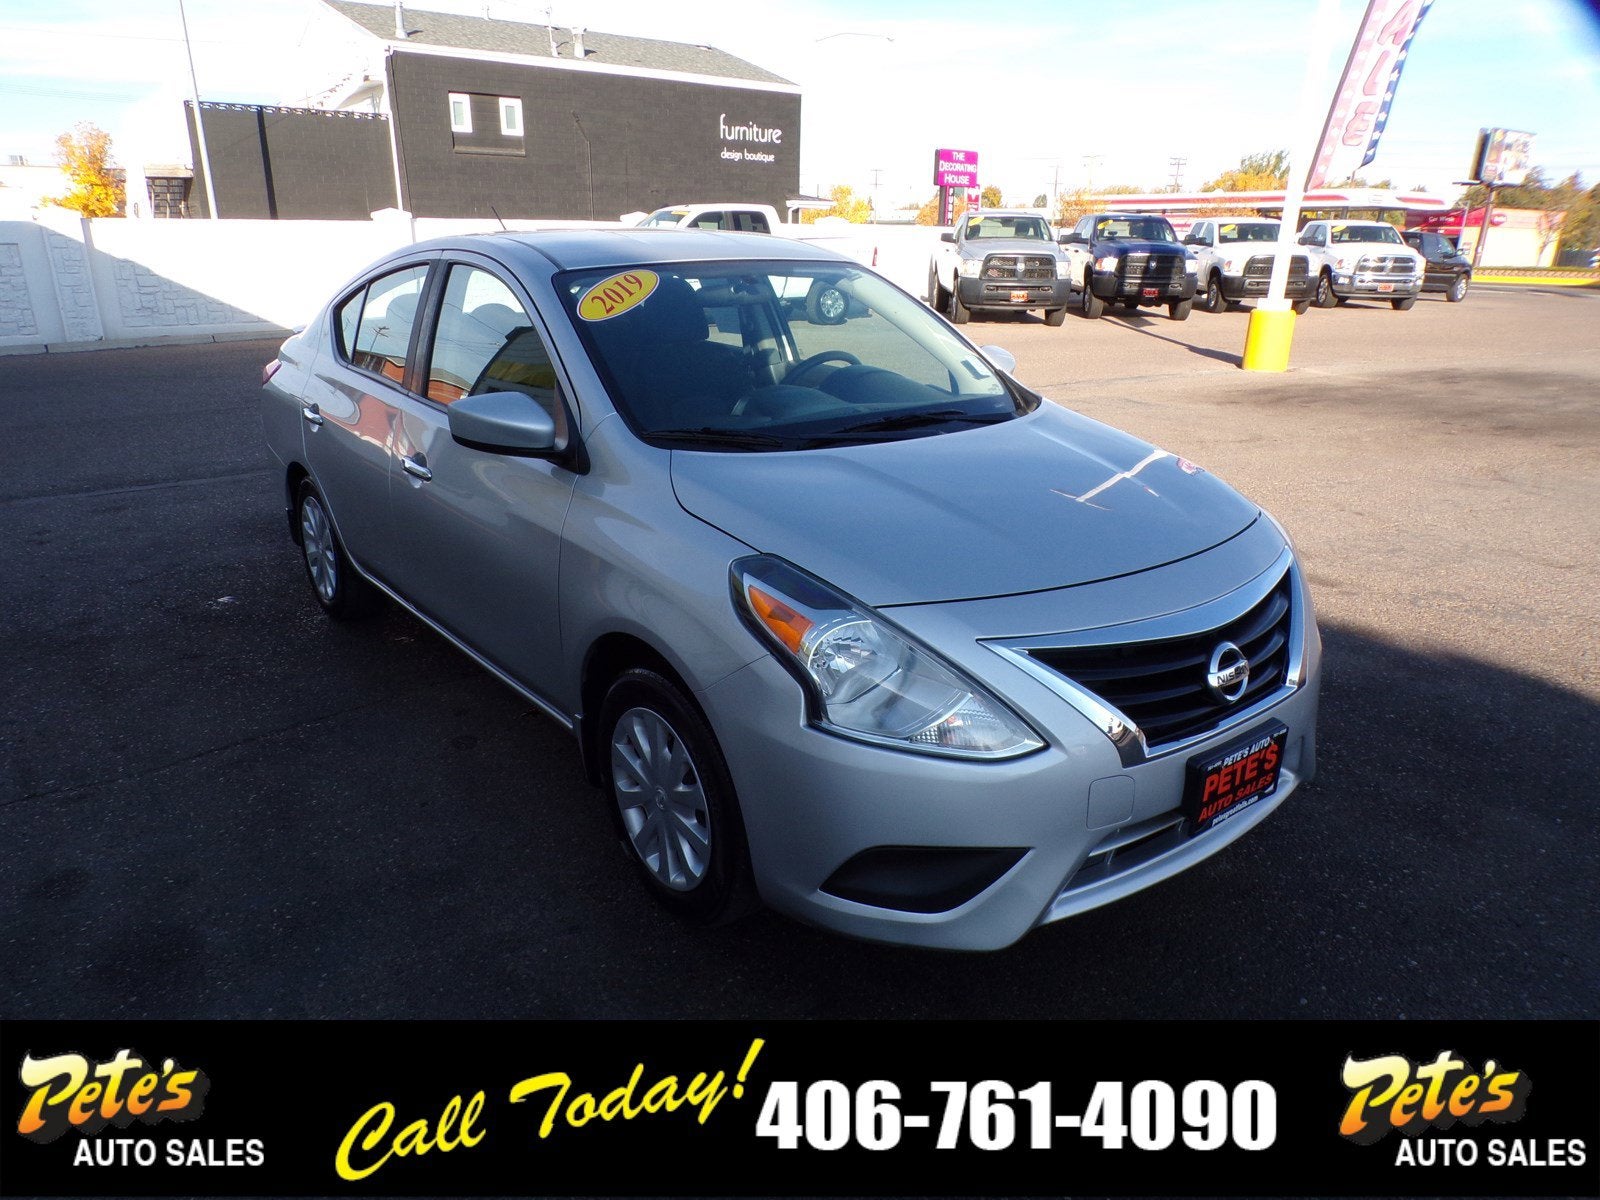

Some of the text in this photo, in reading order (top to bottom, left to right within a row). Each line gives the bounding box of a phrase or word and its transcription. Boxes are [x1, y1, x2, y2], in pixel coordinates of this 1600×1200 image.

[720, 113, 782, 143] furniture
[720, 147, 775, 163] design boutique
[938, 161, 977, 173] DECORATING
[952, 151, 966, 161] THE
[944, 173, 970, 185] HOUSE
[591, 274, 643, 314] 2019
[1222, 747, 1250, 768] PETE'S
[1249, 736, 1271, 755] AUTO
[1202, 744, 1278, 802] PETE'S
[1198, 794, 1233, 823] AUTO
[1234, 773, 1274, 802] SALES
